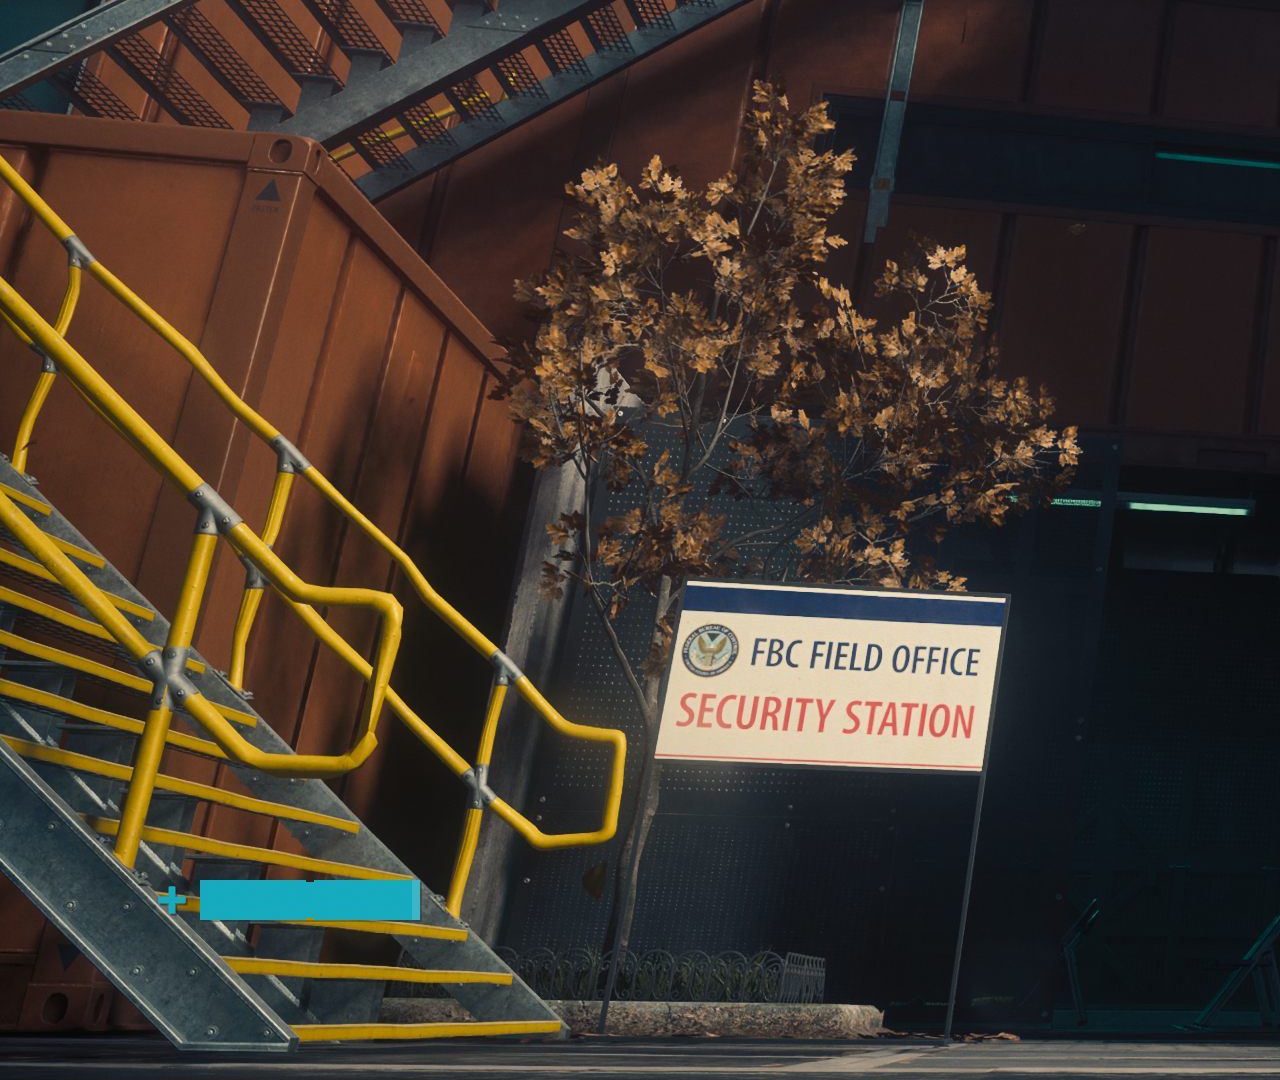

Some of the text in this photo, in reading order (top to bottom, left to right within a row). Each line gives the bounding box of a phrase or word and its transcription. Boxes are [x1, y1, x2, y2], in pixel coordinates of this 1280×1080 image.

[751, 638, 803, 669] FBC
[809, 640, 883, 672] FIELD
[892, 645, 981, 677] OFFICE
[675, 692, 976, 740] SECURITY STATION
